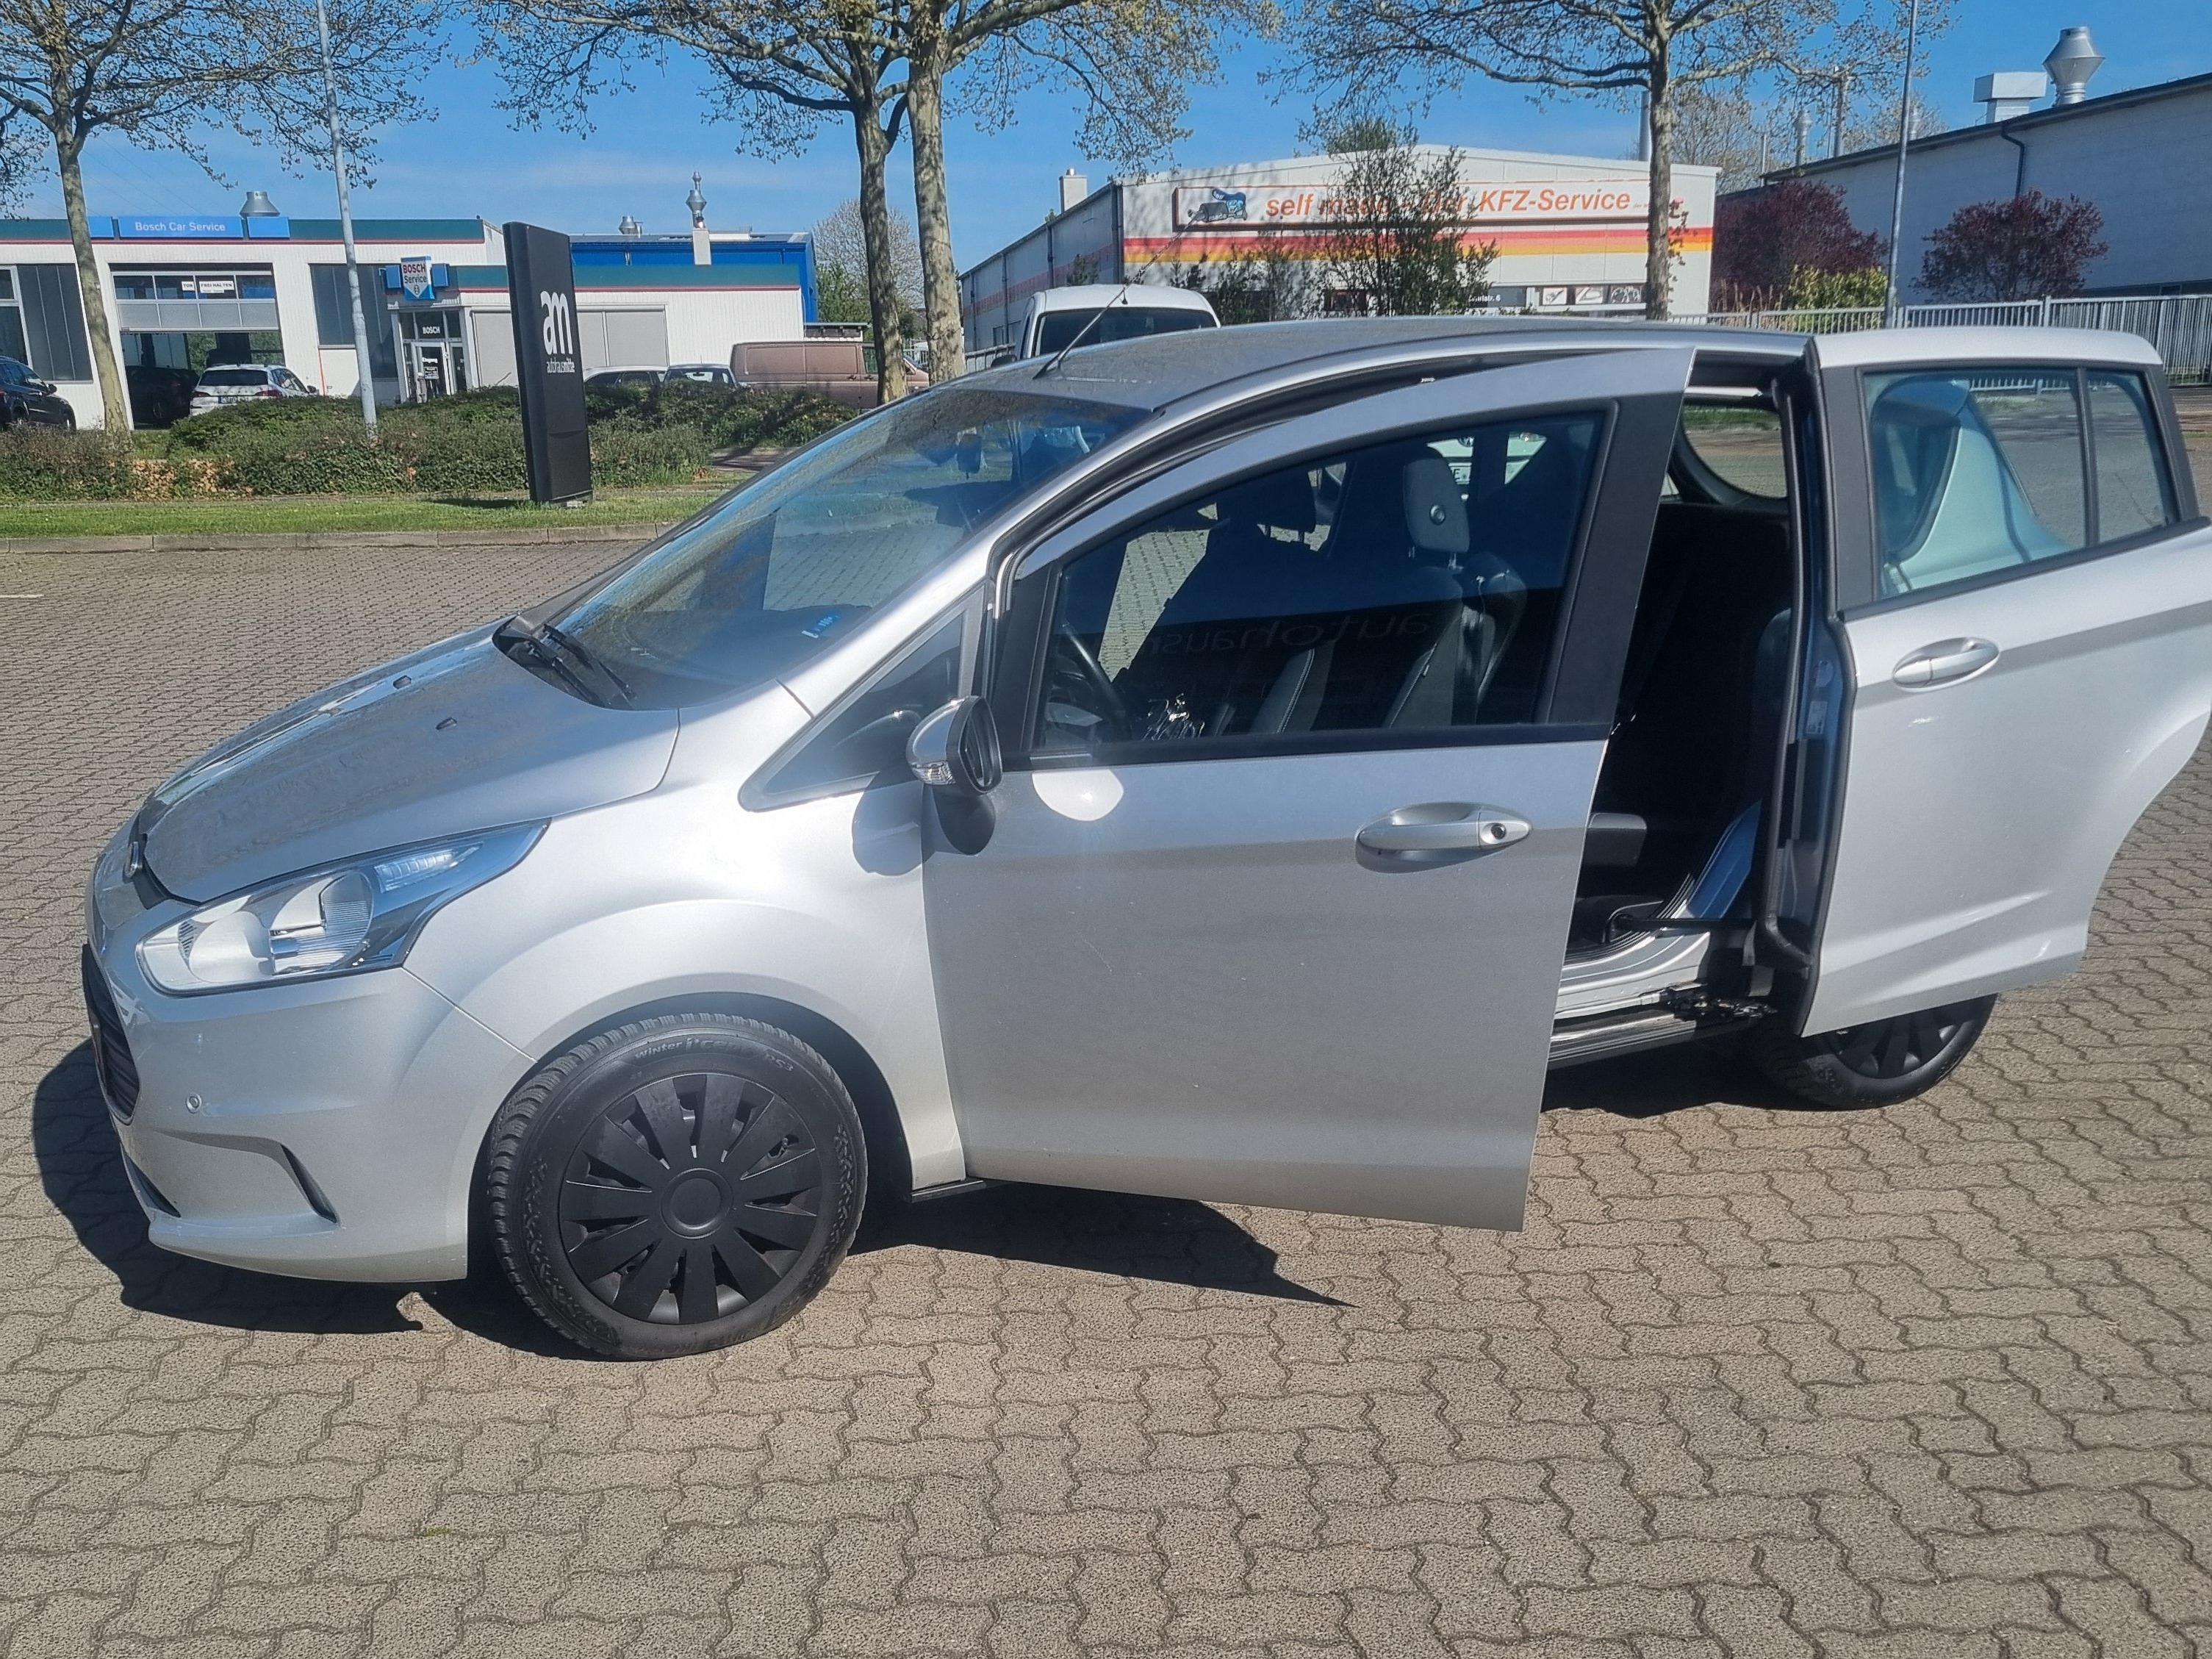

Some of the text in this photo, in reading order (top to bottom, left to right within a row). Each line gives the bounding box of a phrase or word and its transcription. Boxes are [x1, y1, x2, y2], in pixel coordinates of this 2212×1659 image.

[1266, 193, 1314, 216] self
[1479, 189, 1631, 212] KFZ-Service
[135, 222, 226, 232] Bosch Car Service
[403, 264, 426, 273] BOSCH
[404, 275, 427, 284] Service
[540, 290, 573, 355] am
[423, 326, 440, 334] BOSCH
